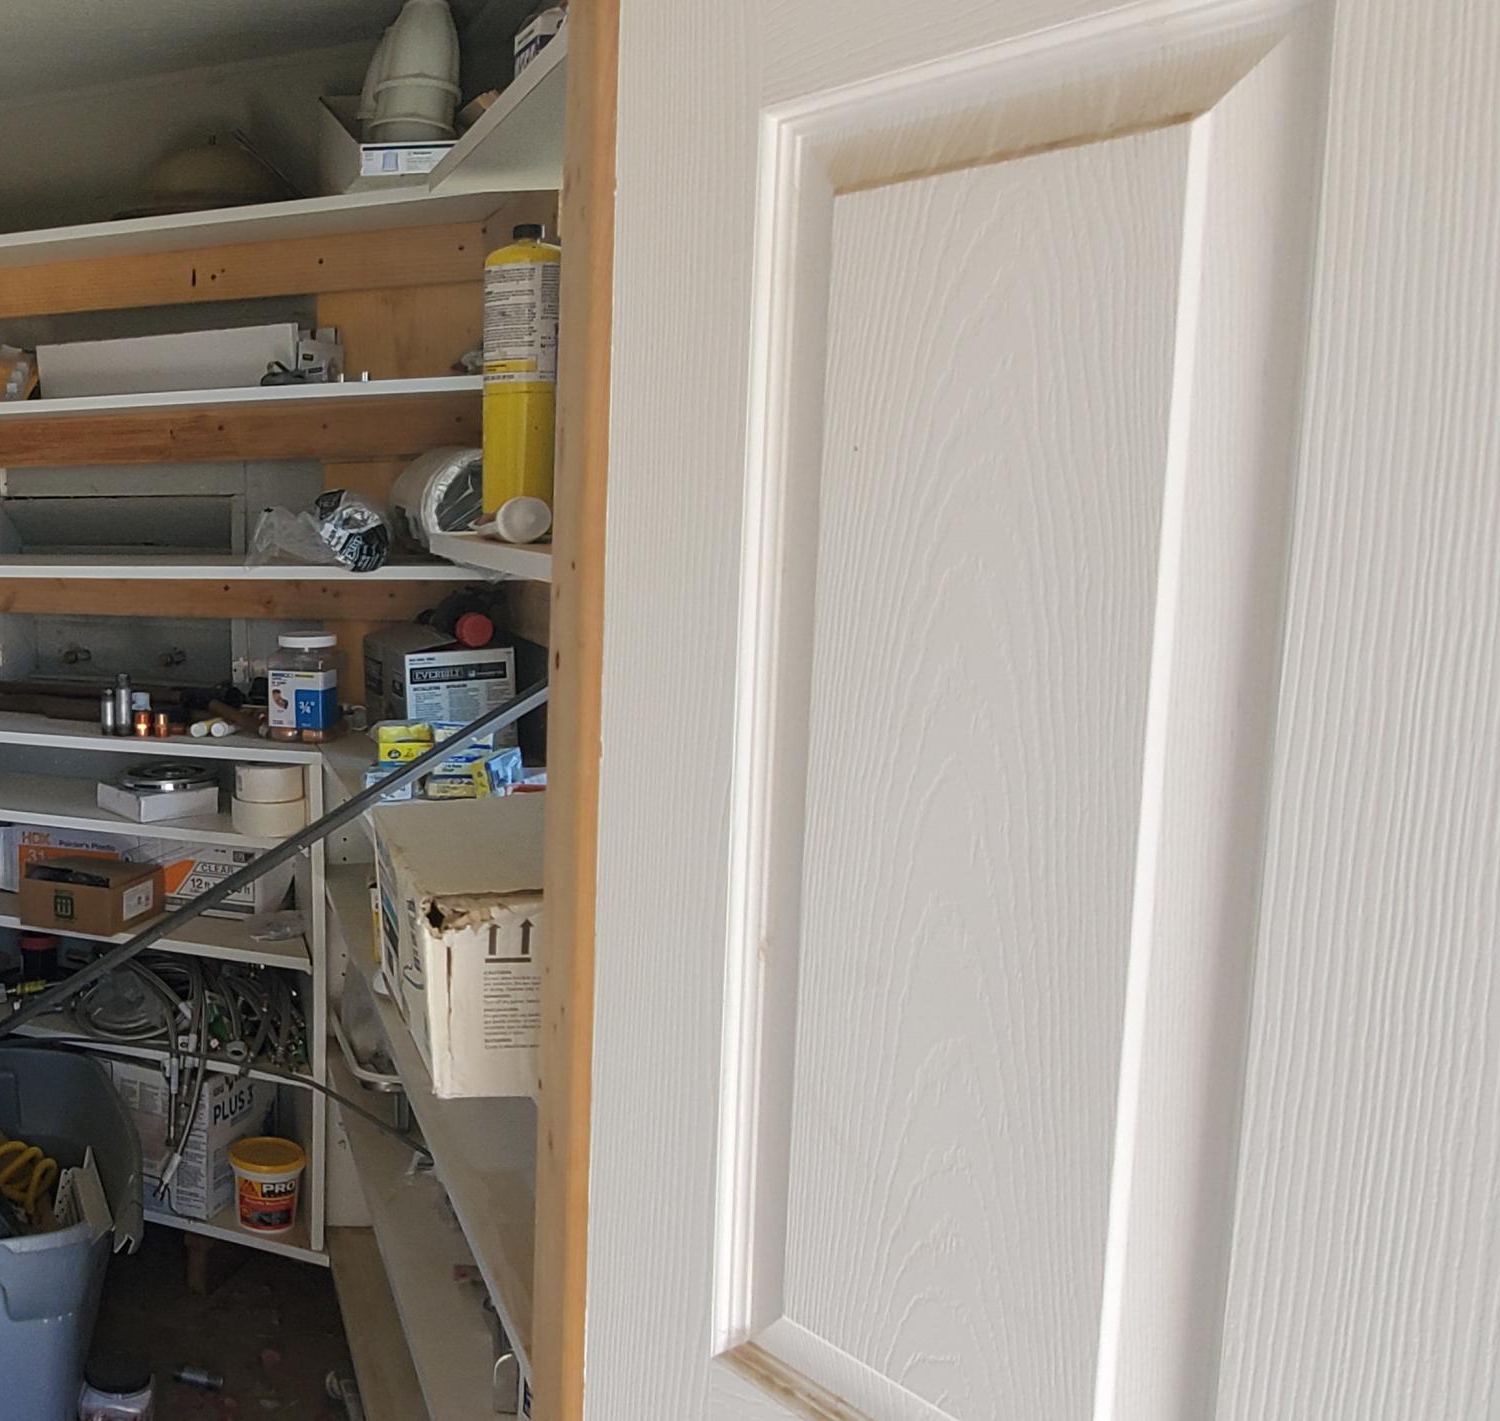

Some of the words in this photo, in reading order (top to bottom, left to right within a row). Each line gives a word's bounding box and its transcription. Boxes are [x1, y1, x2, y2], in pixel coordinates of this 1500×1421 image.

[22, 831, 52, 845] HDX
[59, 839, 90, 849] Painter's
[91, 841, 116, 852] Plastic
[201, 862, 235, 875] CLEAR
[191, 877, 203, 889] 12
[213, 1092, 245, 1125] PLUS
[262, 1180, 296, 1193] PRO
